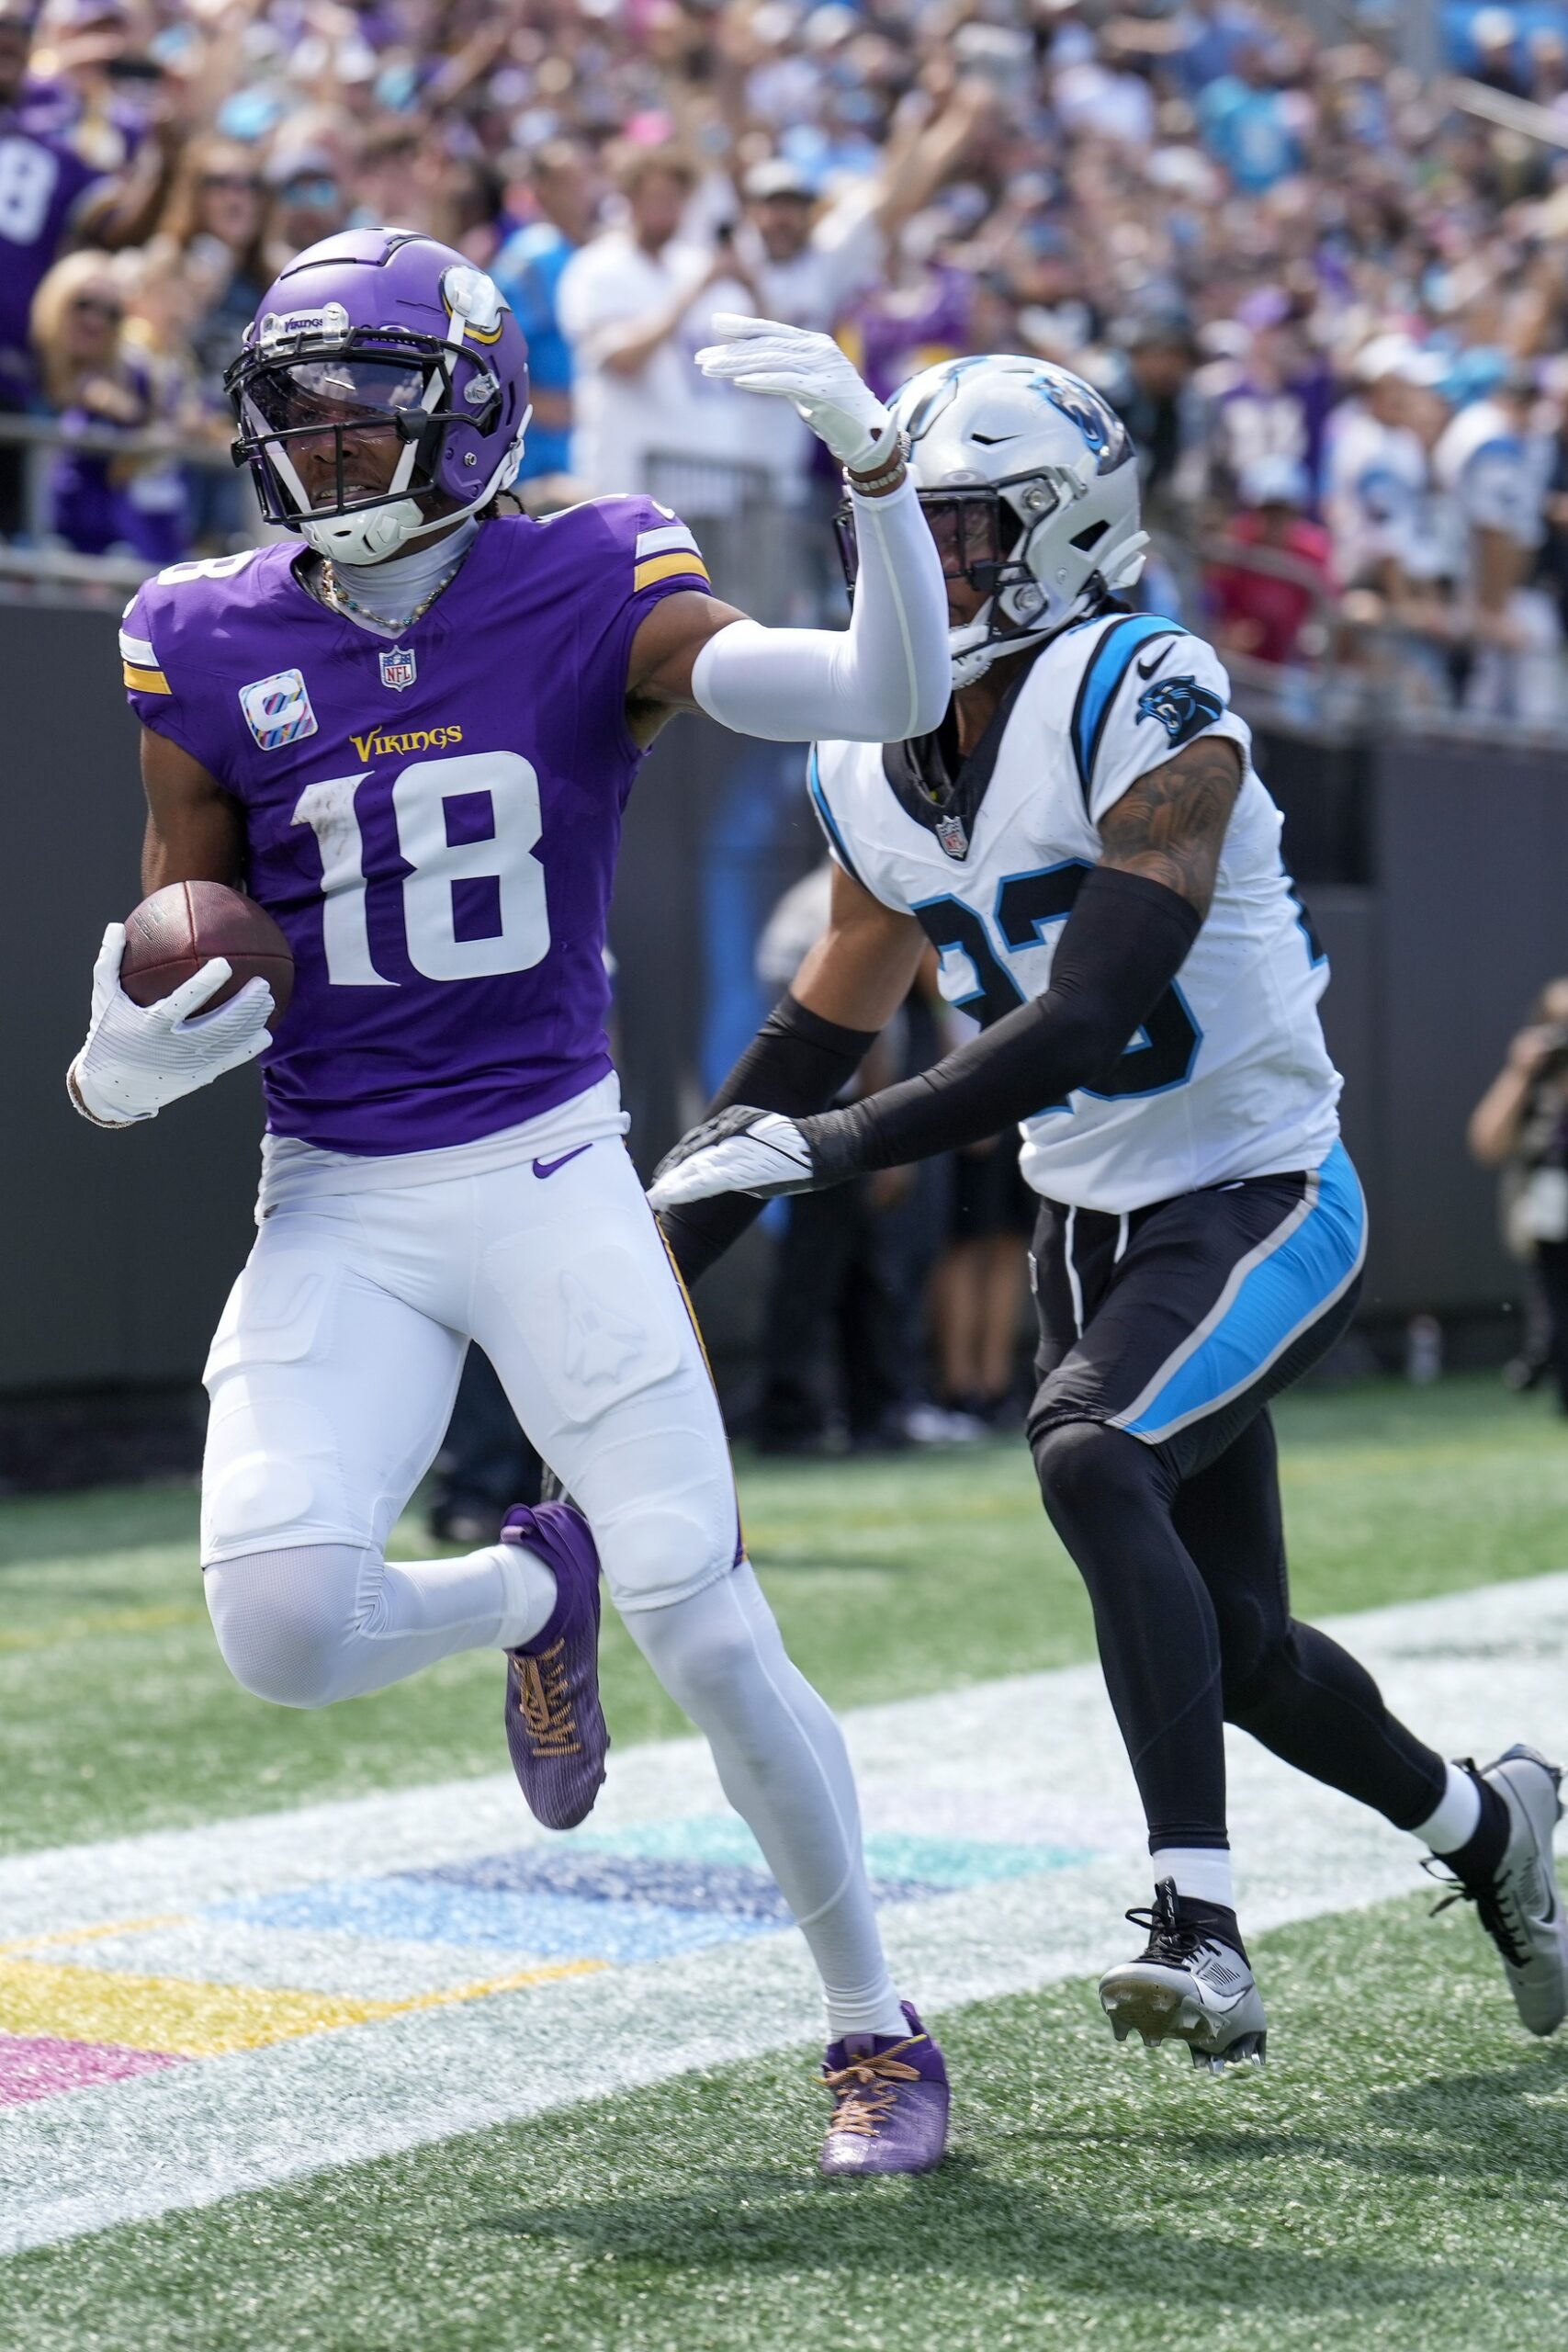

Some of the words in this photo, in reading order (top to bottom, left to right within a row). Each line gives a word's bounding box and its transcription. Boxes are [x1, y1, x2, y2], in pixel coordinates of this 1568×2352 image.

[386, 665, 411, 683] NFL
[246, 675, 306, 731] C
[289, 750, 551, 987] 18
